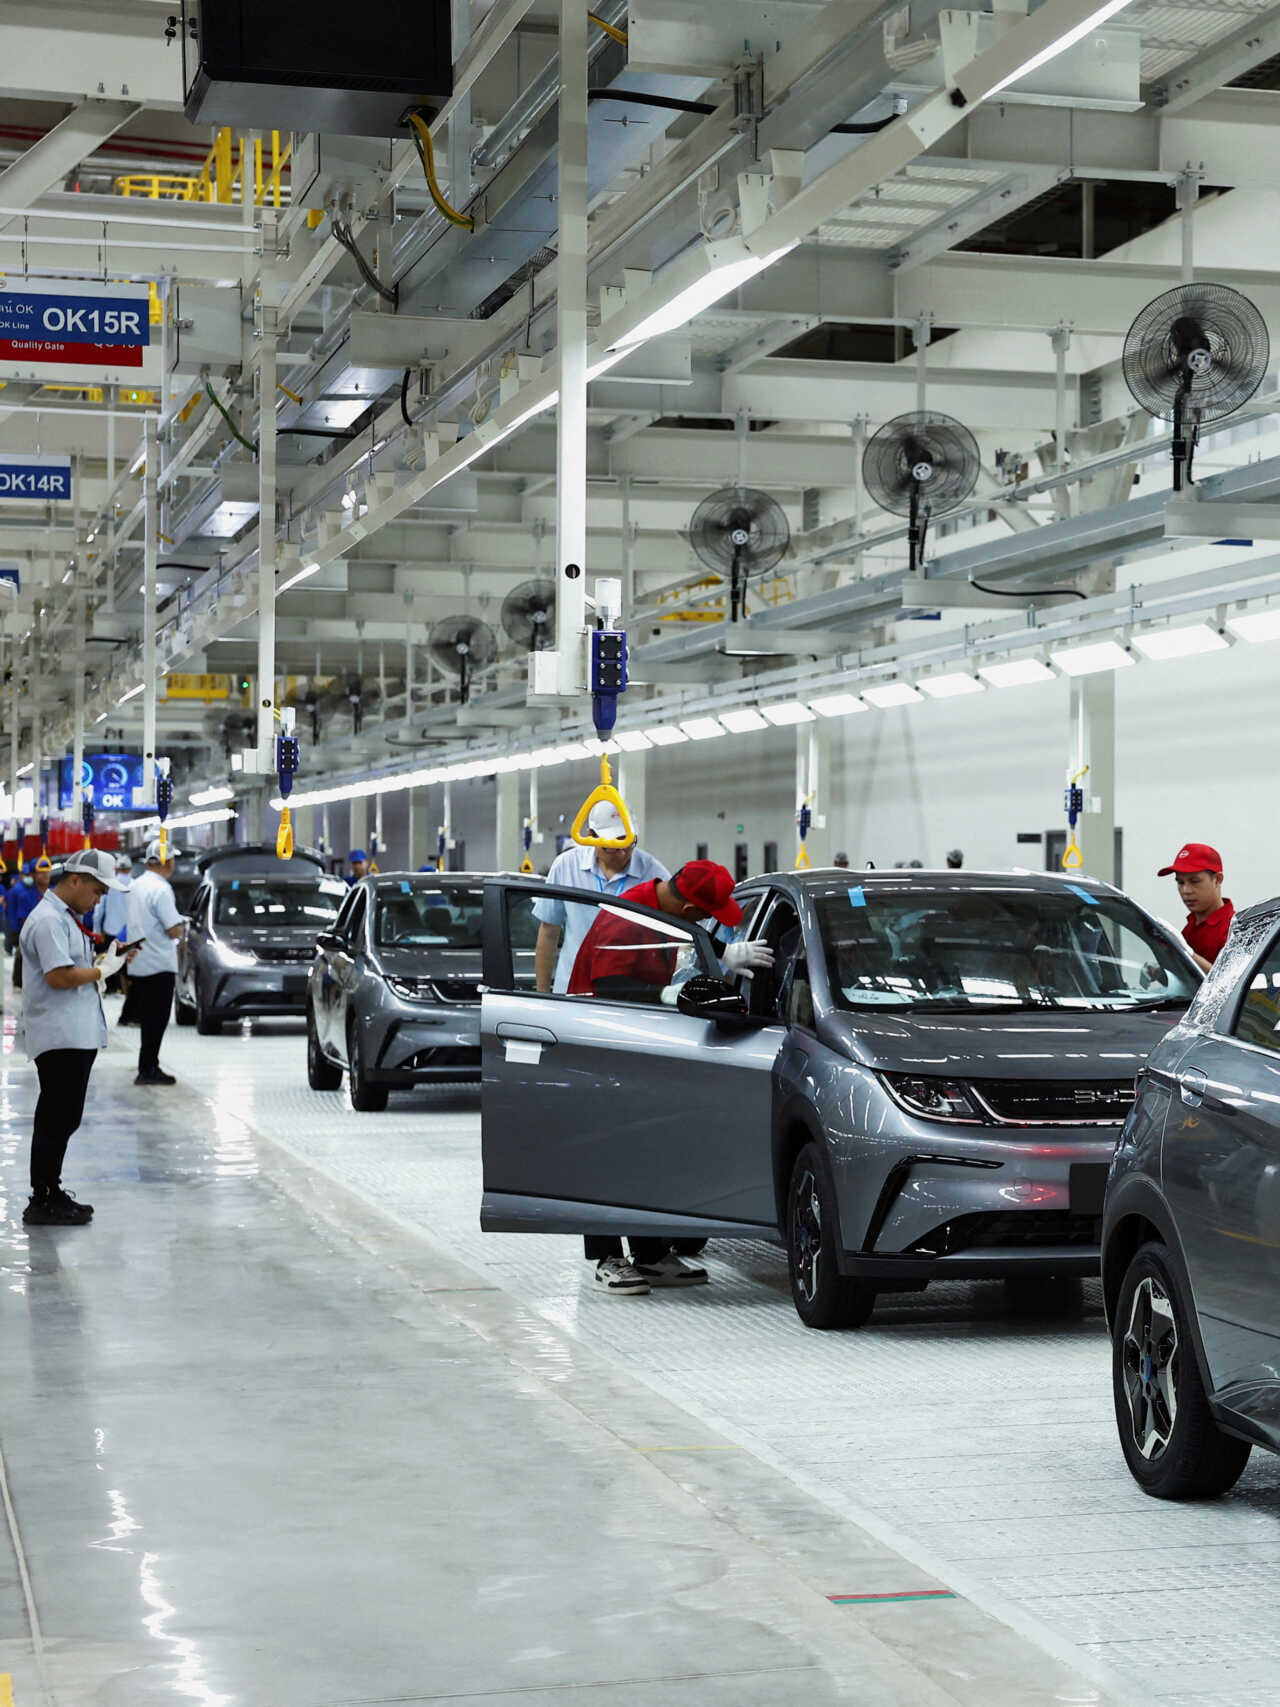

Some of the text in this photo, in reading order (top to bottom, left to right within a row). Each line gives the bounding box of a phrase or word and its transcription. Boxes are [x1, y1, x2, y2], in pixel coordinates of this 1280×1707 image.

[16, 303, 34, 314] OK
[13, 320, 30, 329] Line
[42, 307, 141, 335] OK15R
[11, 340, 65, 351] Quality Gate
[0, 473, 65, 492] OK14R
[102, 794, 124, 808] OK
